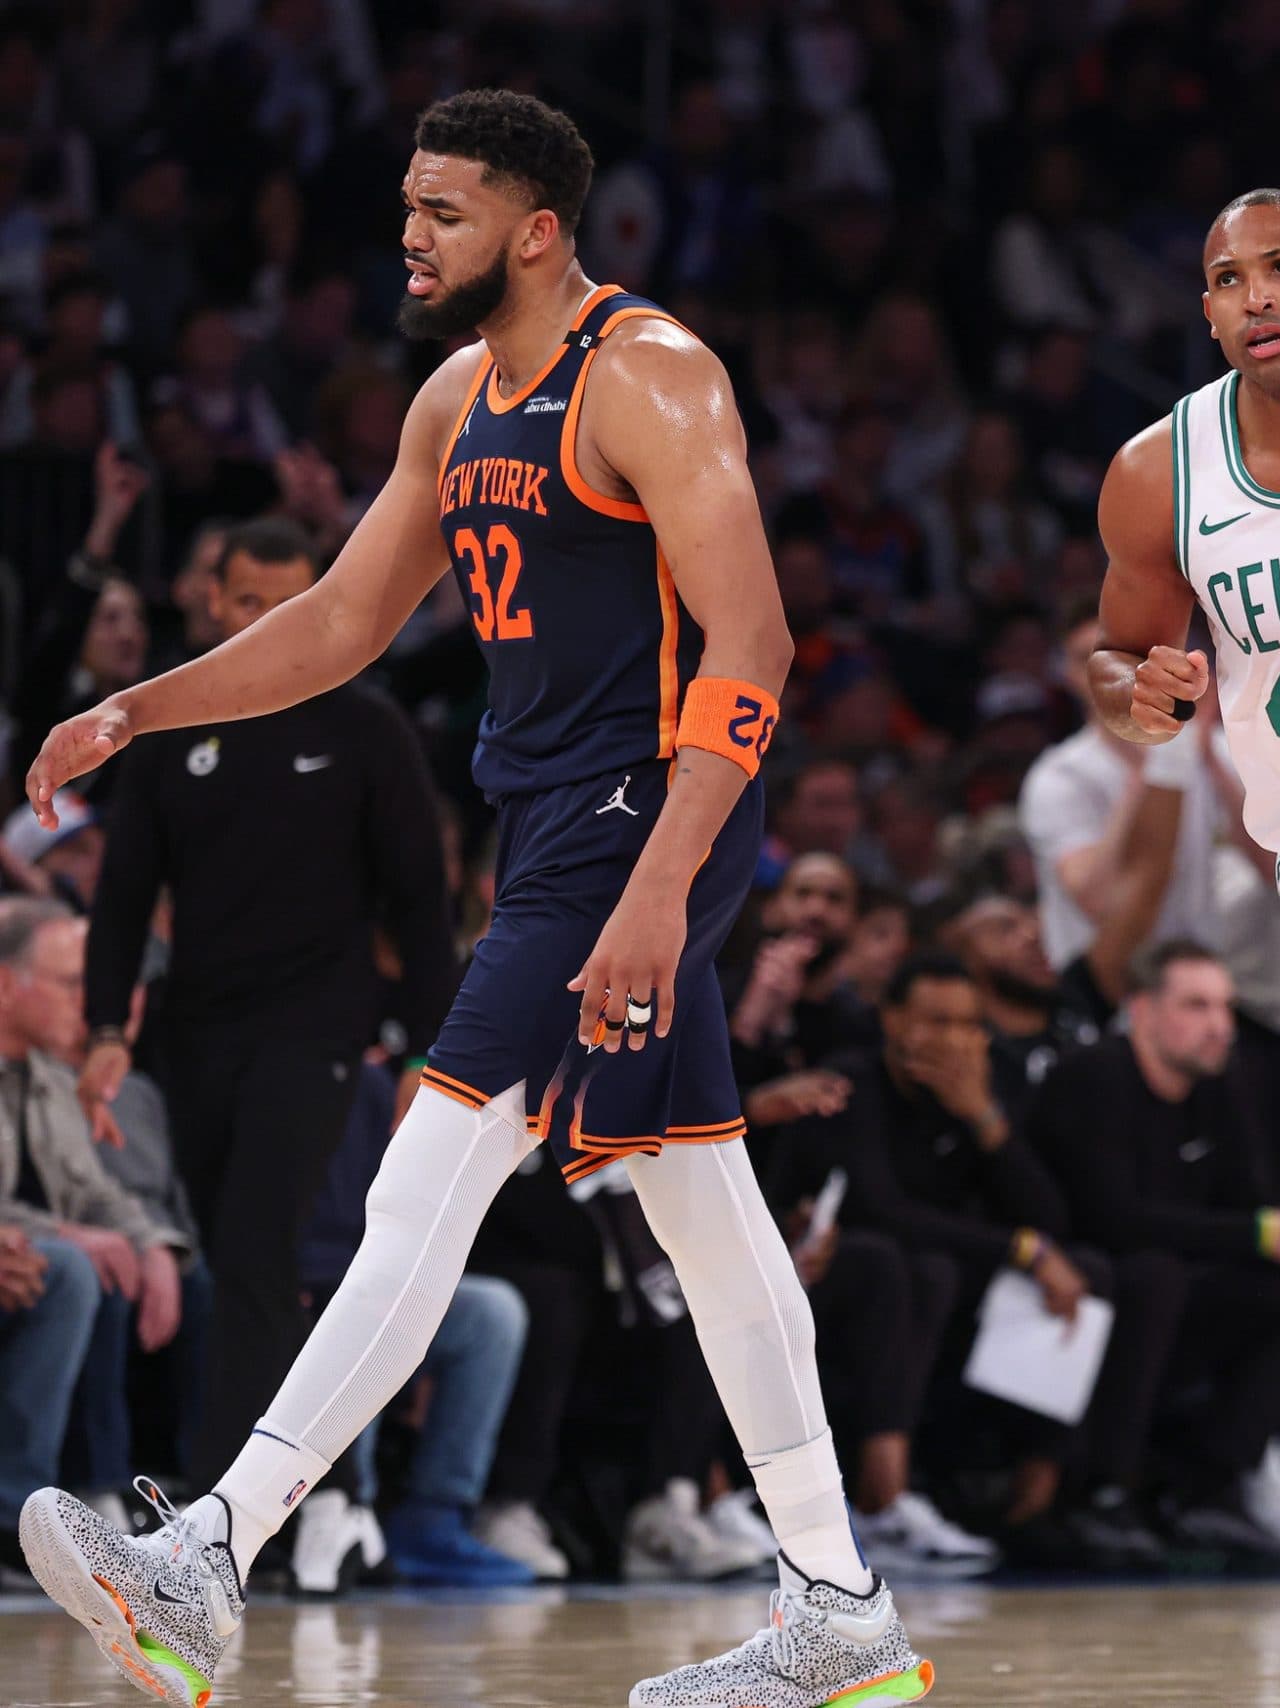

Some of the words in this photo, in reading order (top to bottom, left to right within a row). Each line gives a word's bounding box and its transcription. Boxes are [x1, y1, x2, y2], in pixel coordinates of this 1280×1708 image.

[580, 335, 592, 348] 12
[480, 458, 548, 516] YORK
[455, 524, 533, 641] 32
